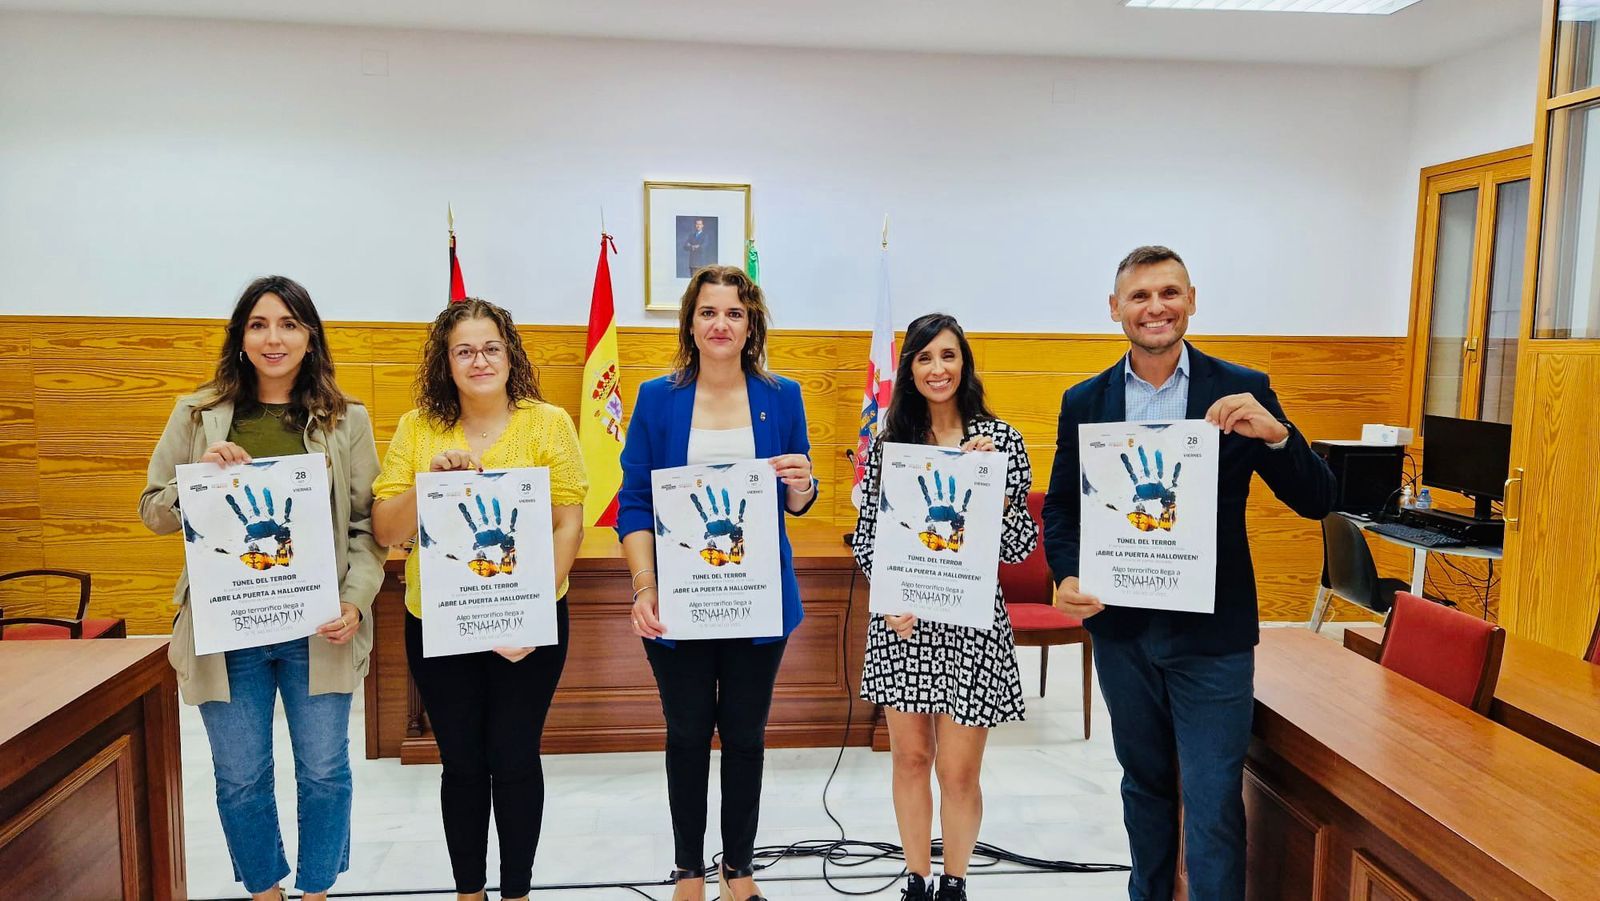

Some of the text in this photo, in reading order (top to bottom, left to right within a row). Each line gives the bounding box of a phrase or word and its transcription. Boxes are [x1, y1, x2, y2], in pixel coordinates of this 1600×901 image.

[270, 574, 297, 582] TERROR
[943, 572, 981, 581] HALLOWEEN!
[1114, 574, 1180, 591] BENAHADUX
[243, 590, 269, 599] PUERTA
[278, 584, 320, 594] HALLOWEEN!
[901, 589, 963, 606] BENAHADUX
[234, 610, 306, 631] BENAHADUX
[691, 607, 752, 623] BENAHADUX
[458, 617, 524, 636] BENAHADUX
